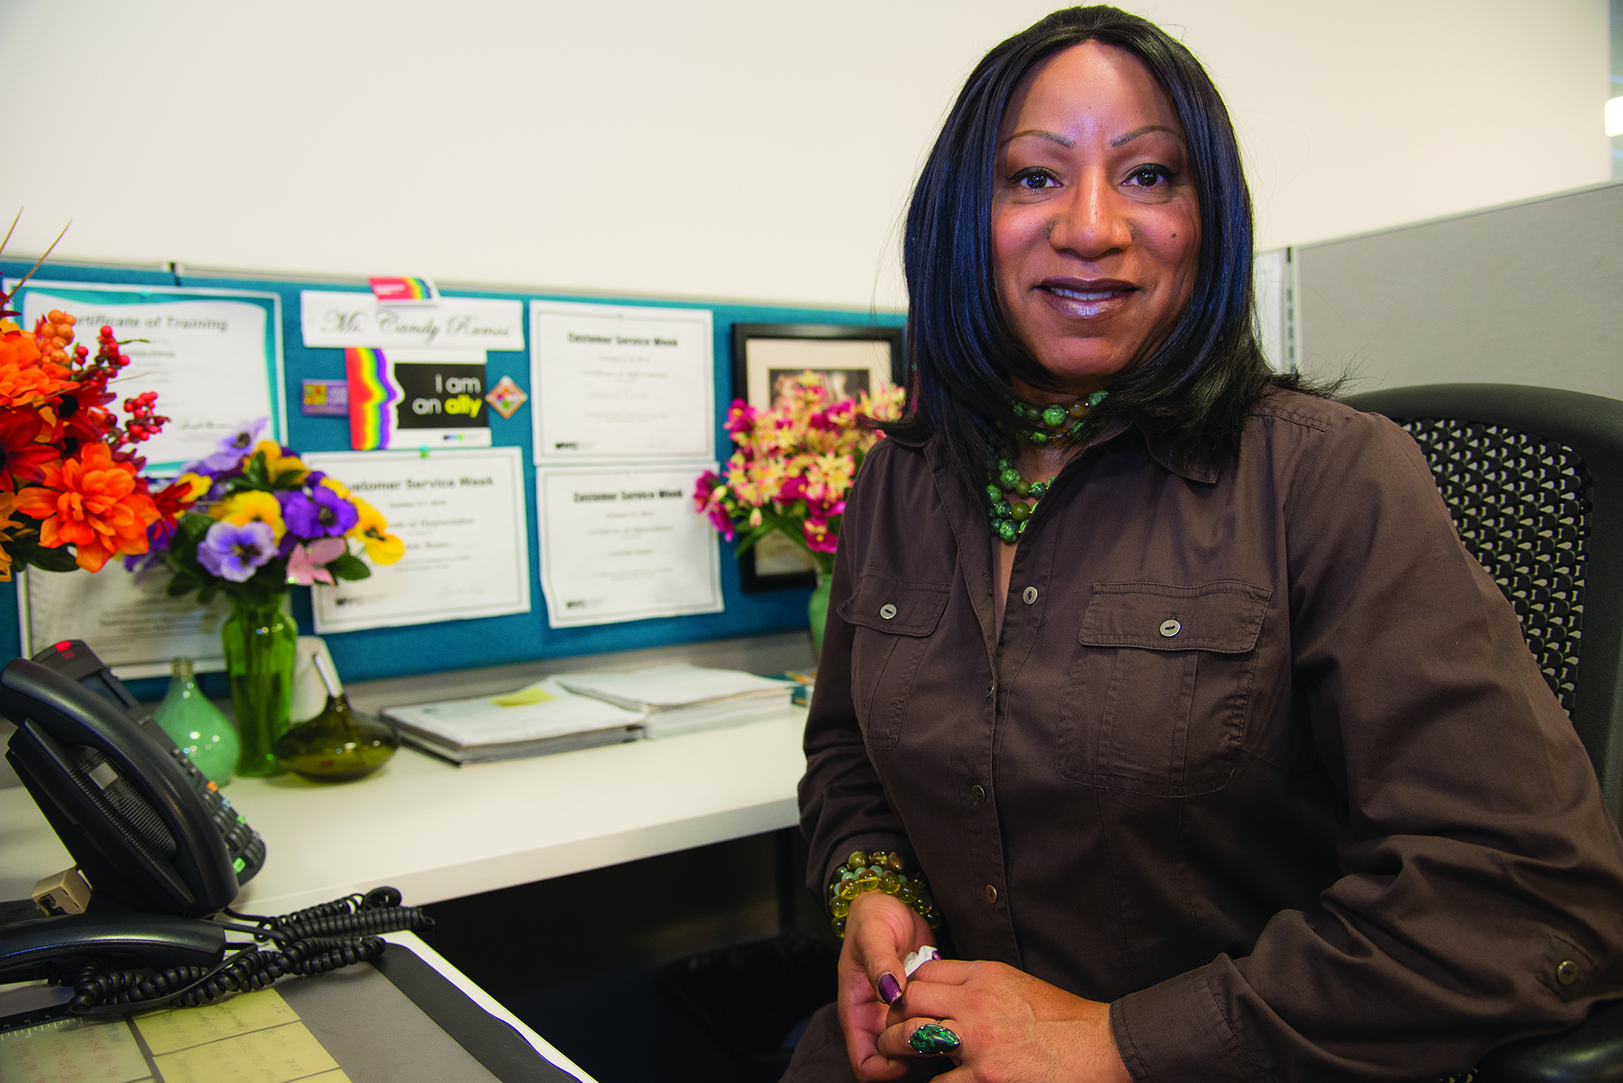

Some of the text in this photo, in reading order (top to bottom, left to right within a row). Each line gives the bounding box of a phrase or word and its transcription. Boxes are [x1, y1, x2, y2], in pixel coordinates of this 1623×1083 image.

[145, 315, 162, 327] of
[166, 316, 229, 331] Training
[376, 309, 440, 342] Candy
[435, 374, 481, 394] I am
[412, 394, 482, 418] an ally
[344, 475, 494, 493] ustomer Service Week
